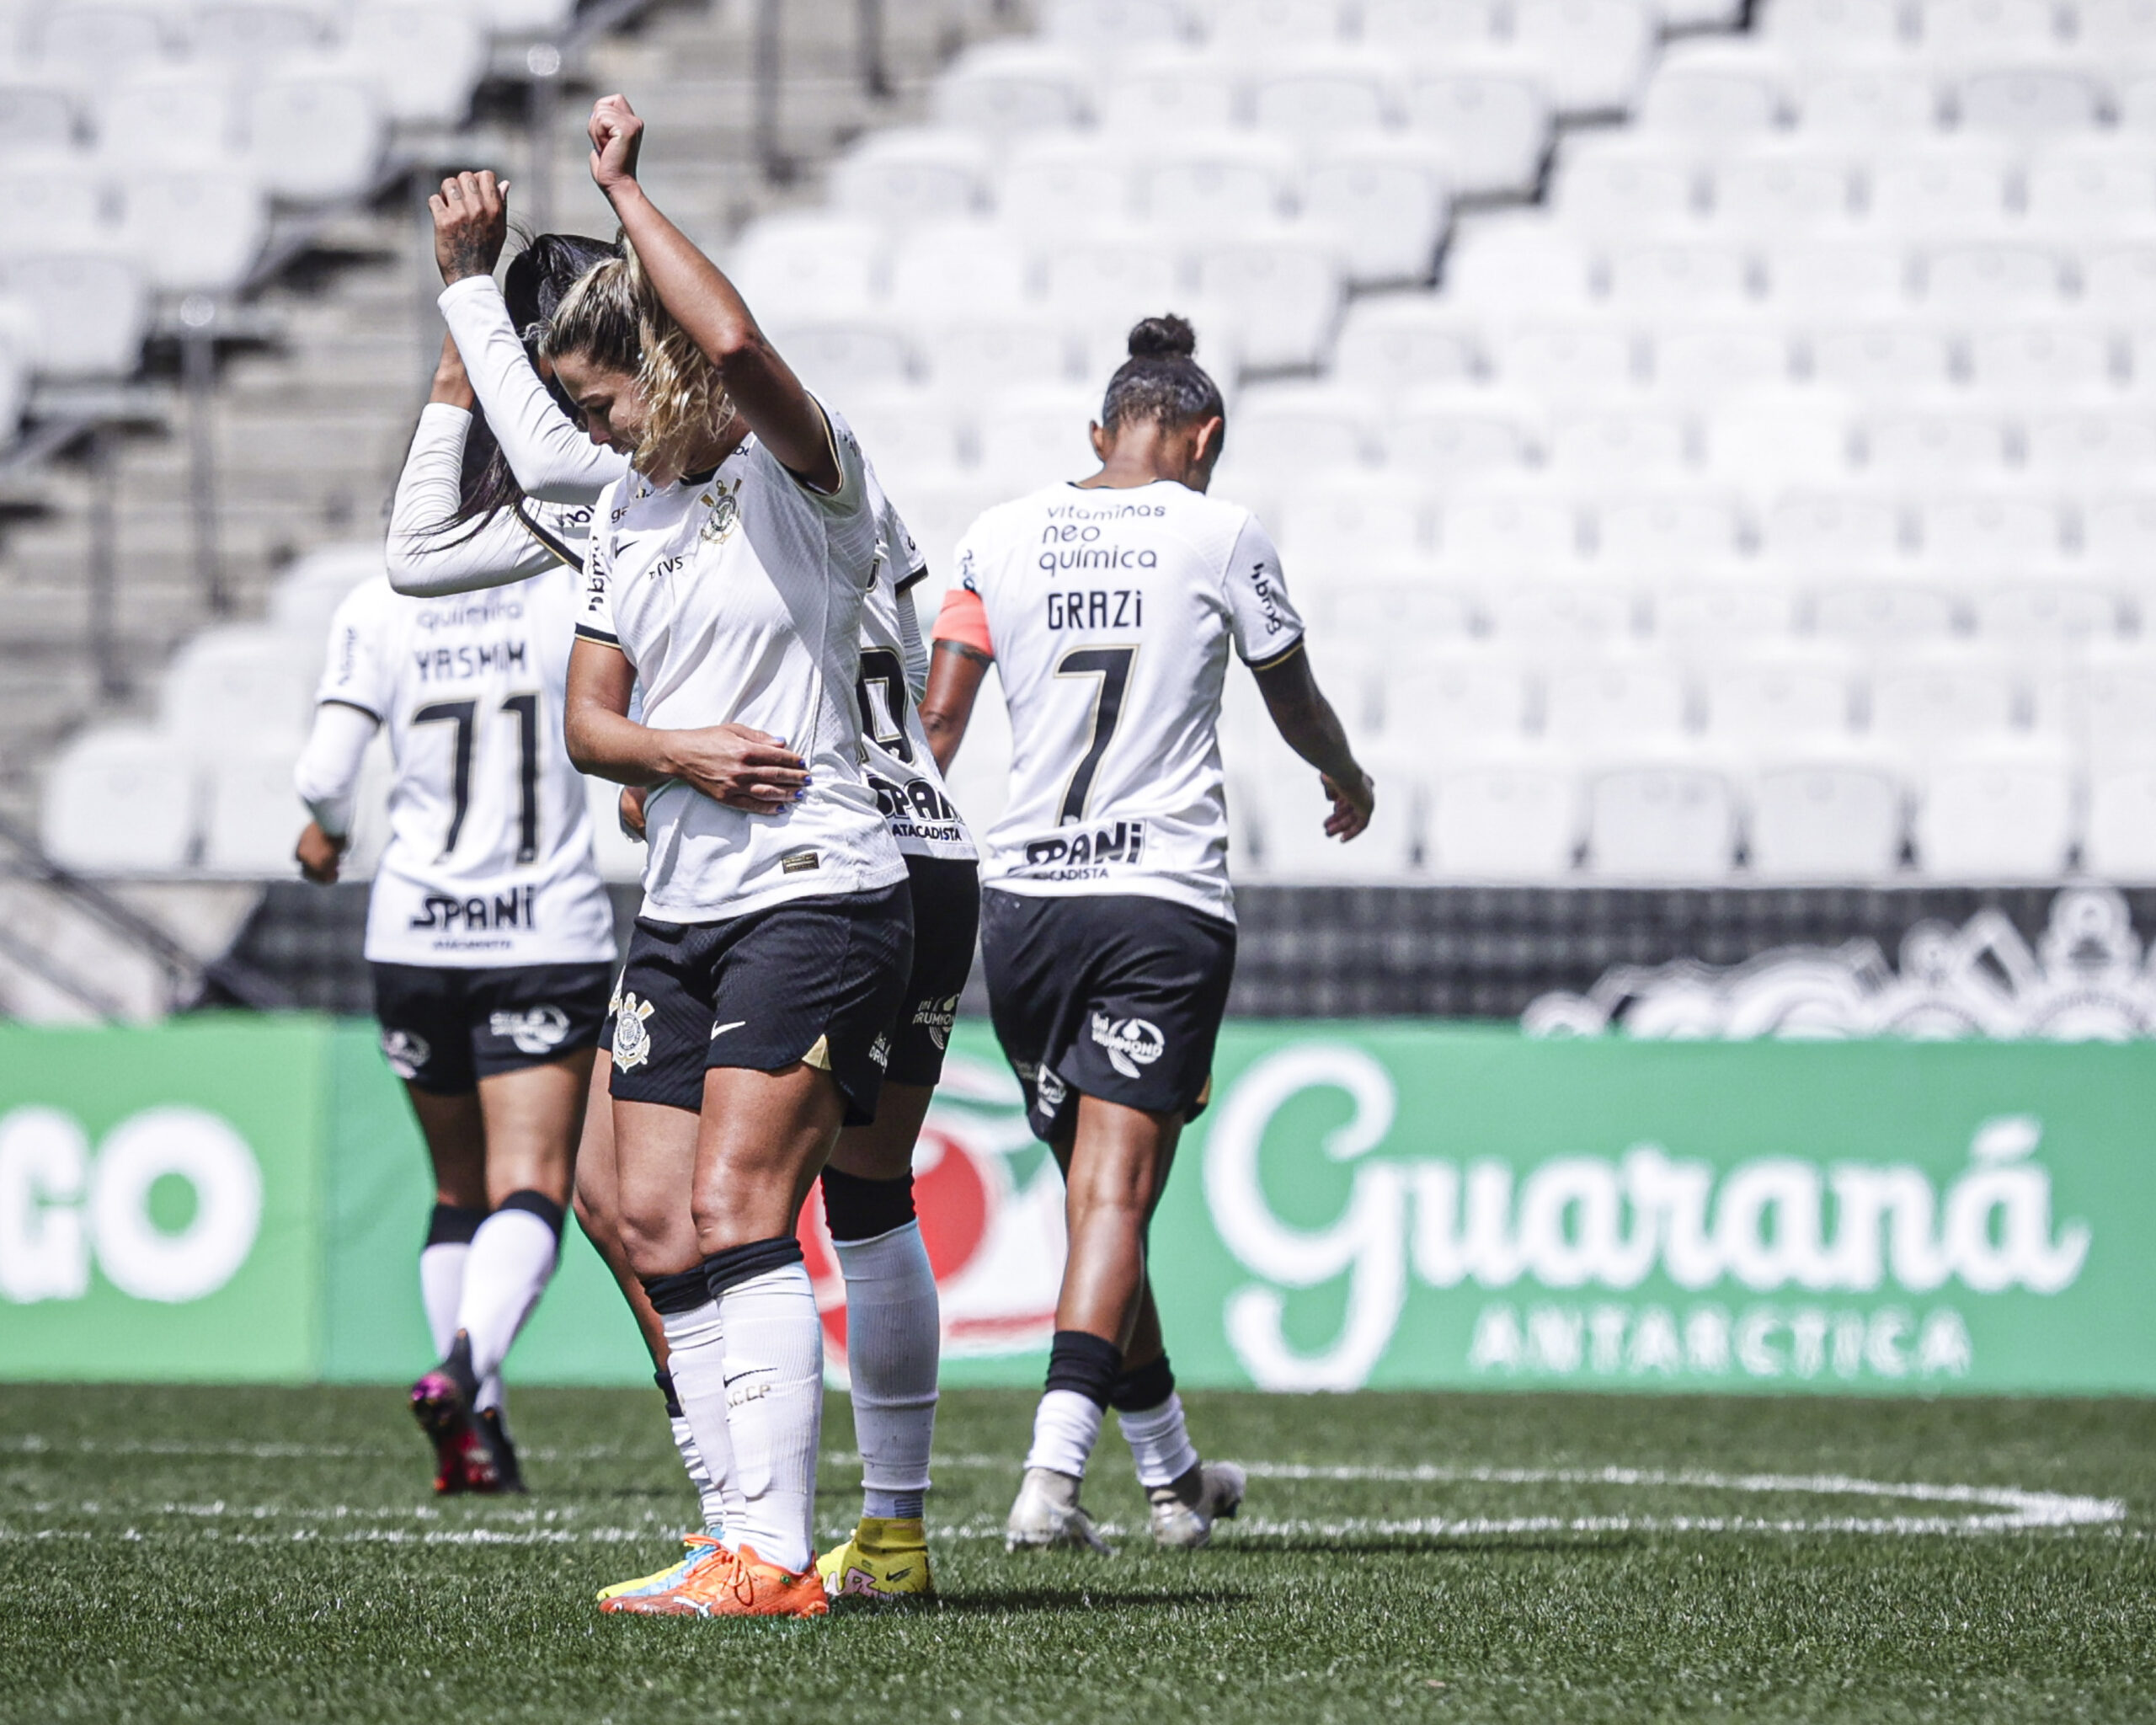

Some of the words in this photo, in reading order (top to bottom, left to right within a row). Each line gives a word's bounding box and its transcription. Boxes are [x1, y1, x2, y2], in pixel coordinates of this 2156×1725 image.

[1042, 525, 1101, 544] neo
[1048, 505, 1166, 521] vitaminas
[1038, 544, 1158, 578] química
[1053, 644, 1140, 828] 7
[408, 690, 543, 866] 71
[892, 823, 963, 841] ATACADISTA
[0, 1104, 263, 1305] GO
[1202, 1039, 2092, 1393] Guaraná
[1470, 1302, 1973, 1377] ANTARCTICA
